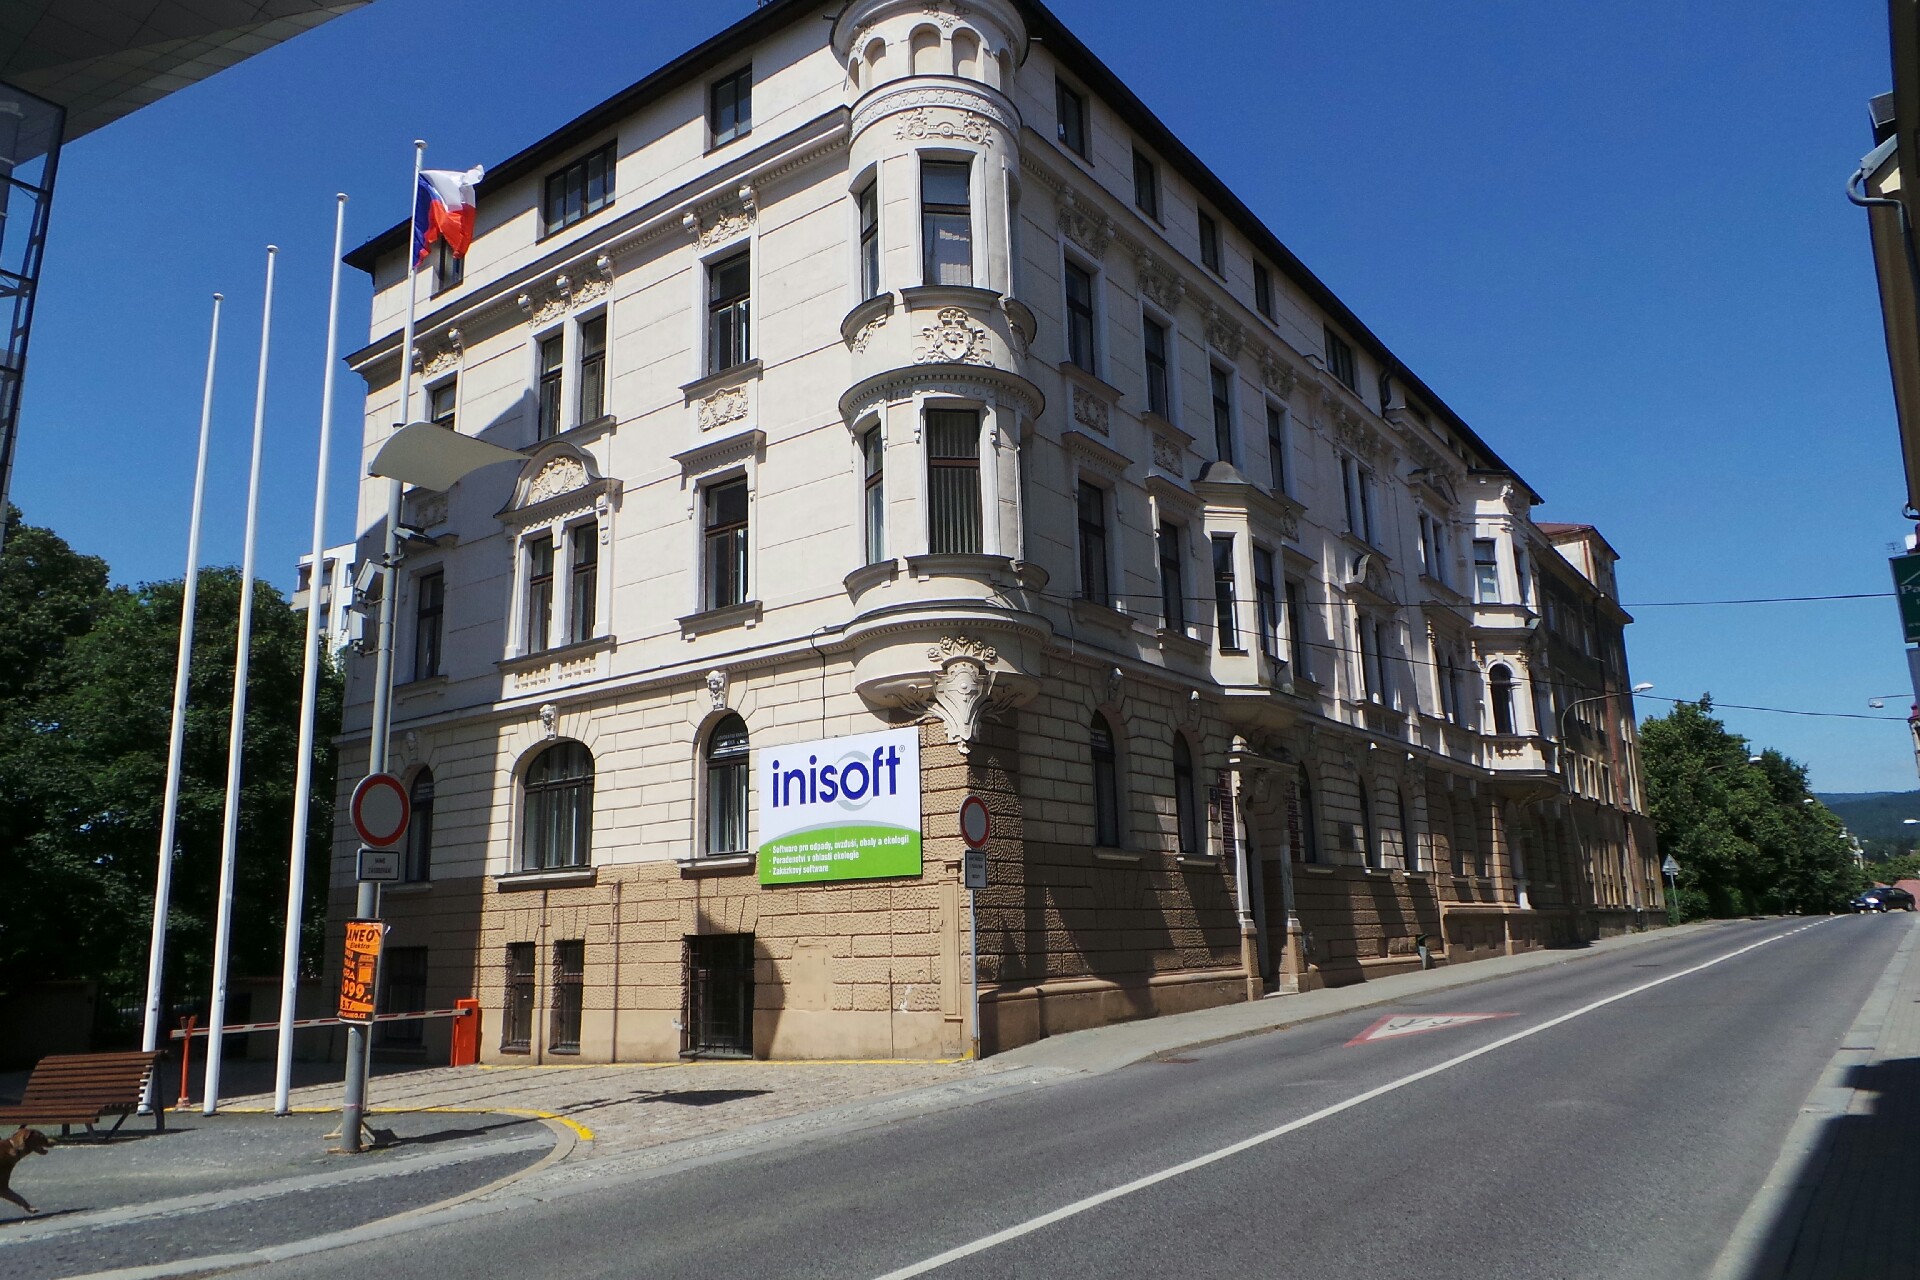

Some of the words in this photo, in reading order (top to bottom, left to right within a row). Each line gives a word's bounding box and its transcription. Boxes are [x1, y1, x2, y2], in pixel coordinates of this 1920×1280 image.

[772, 745, 900, 808] inisoft
[772, 845, 797, 854] Software
[798, 844, 808, 853] pro
[810, 841, 833, 851] odpady,
[833, 850, 859, 861] ekologie
[803, 864, 829, 874] software
